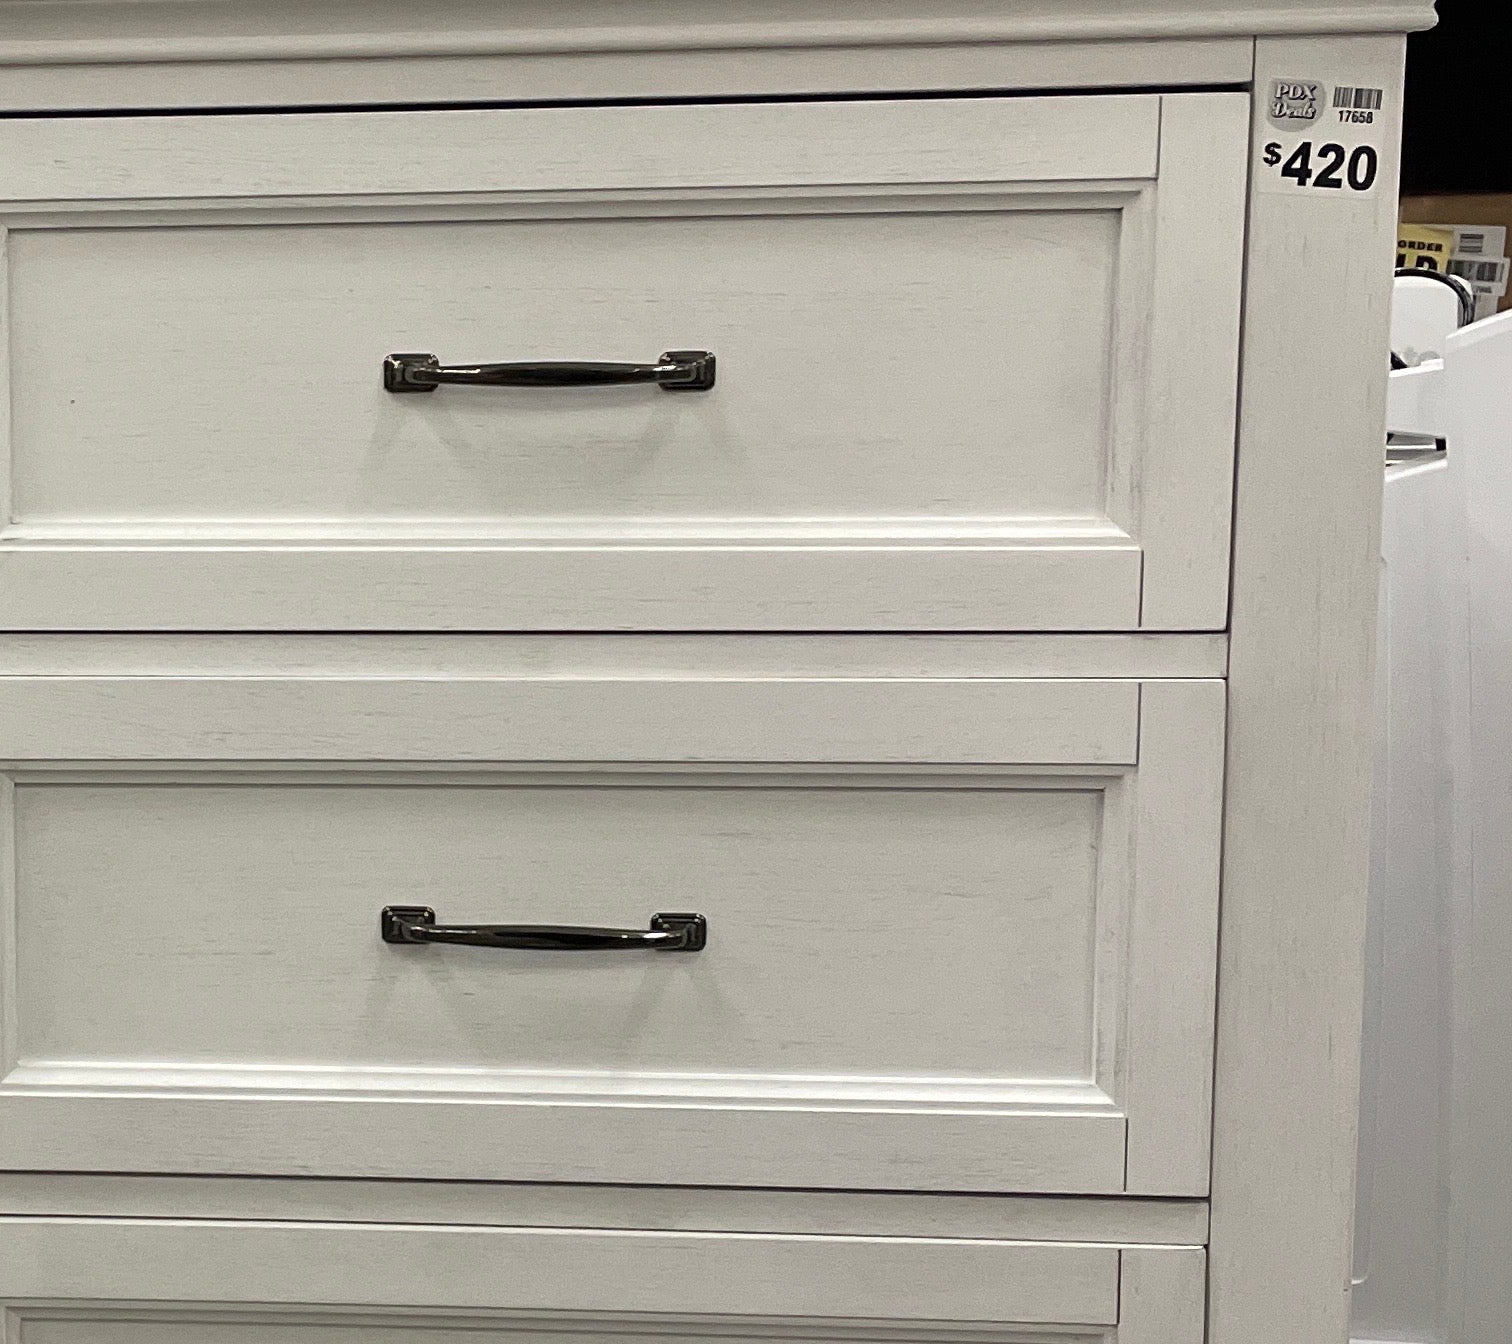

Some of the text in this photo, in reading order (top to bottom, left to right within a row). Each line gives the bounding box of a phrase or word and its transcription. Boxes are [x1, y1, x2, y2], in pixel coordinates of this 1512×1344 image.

[1274, 83, 1317, 102] PDX
[1272, 101, 1317, 120] Deals
[1338, 110, 1374, 124] 17658
[1263, 141, 1378, 191] $420
[1397, 240, 1443, 252] ORDER
